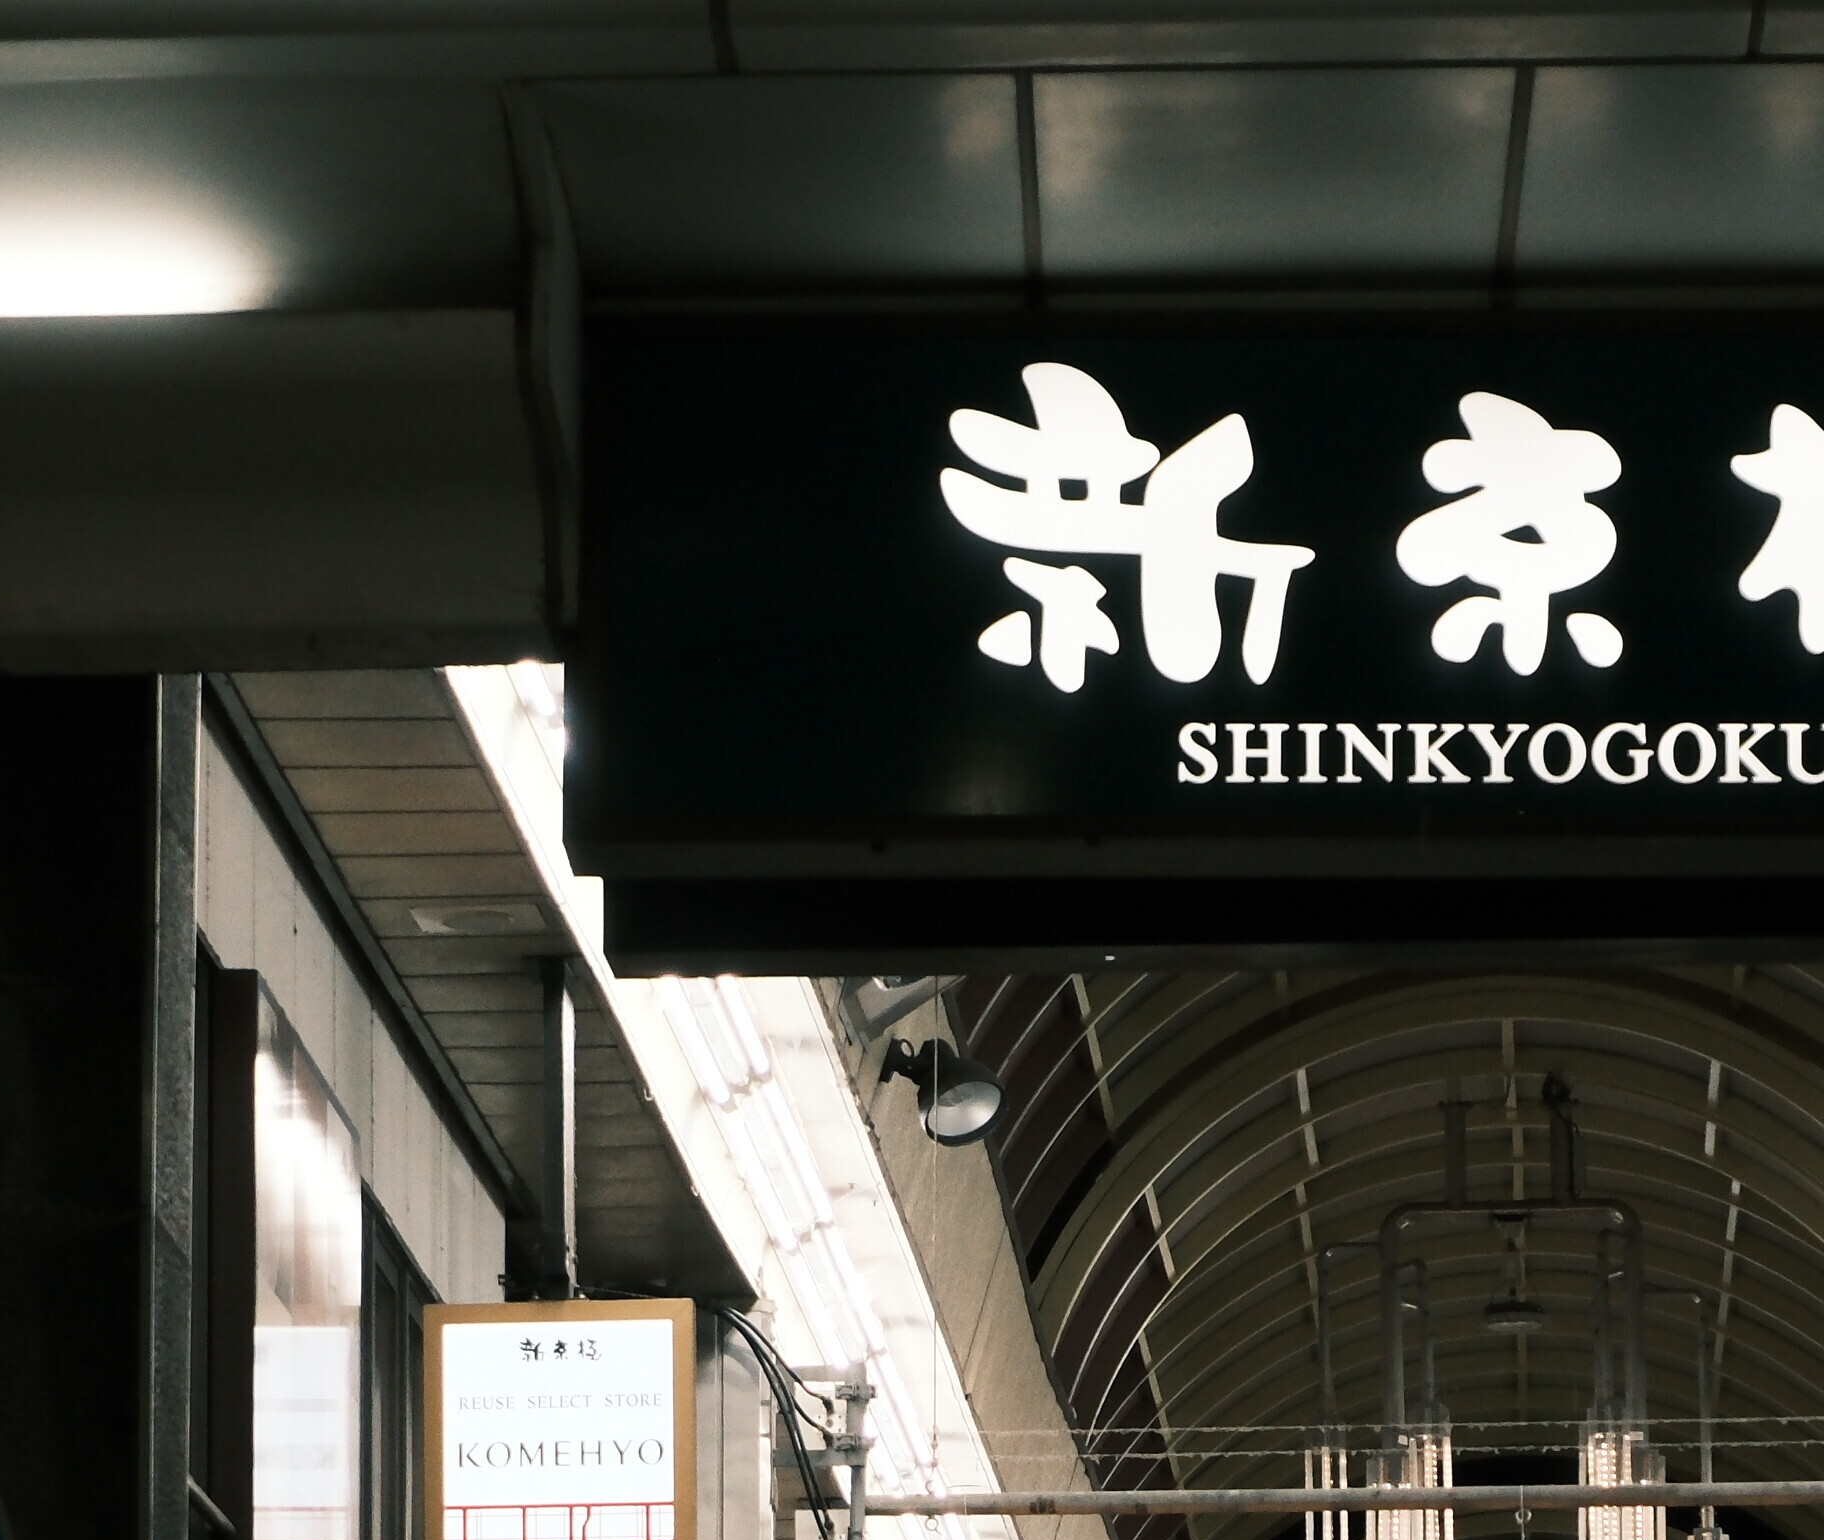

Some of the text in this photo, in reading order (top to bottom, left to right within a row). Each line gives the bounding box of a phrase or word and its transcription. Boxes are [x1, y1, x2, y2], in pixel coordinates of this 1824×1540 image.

[458, 1393, 663, 1410] REUSE SELECT STORE
[458, 1438, 664, 1468] KOMEHYO
